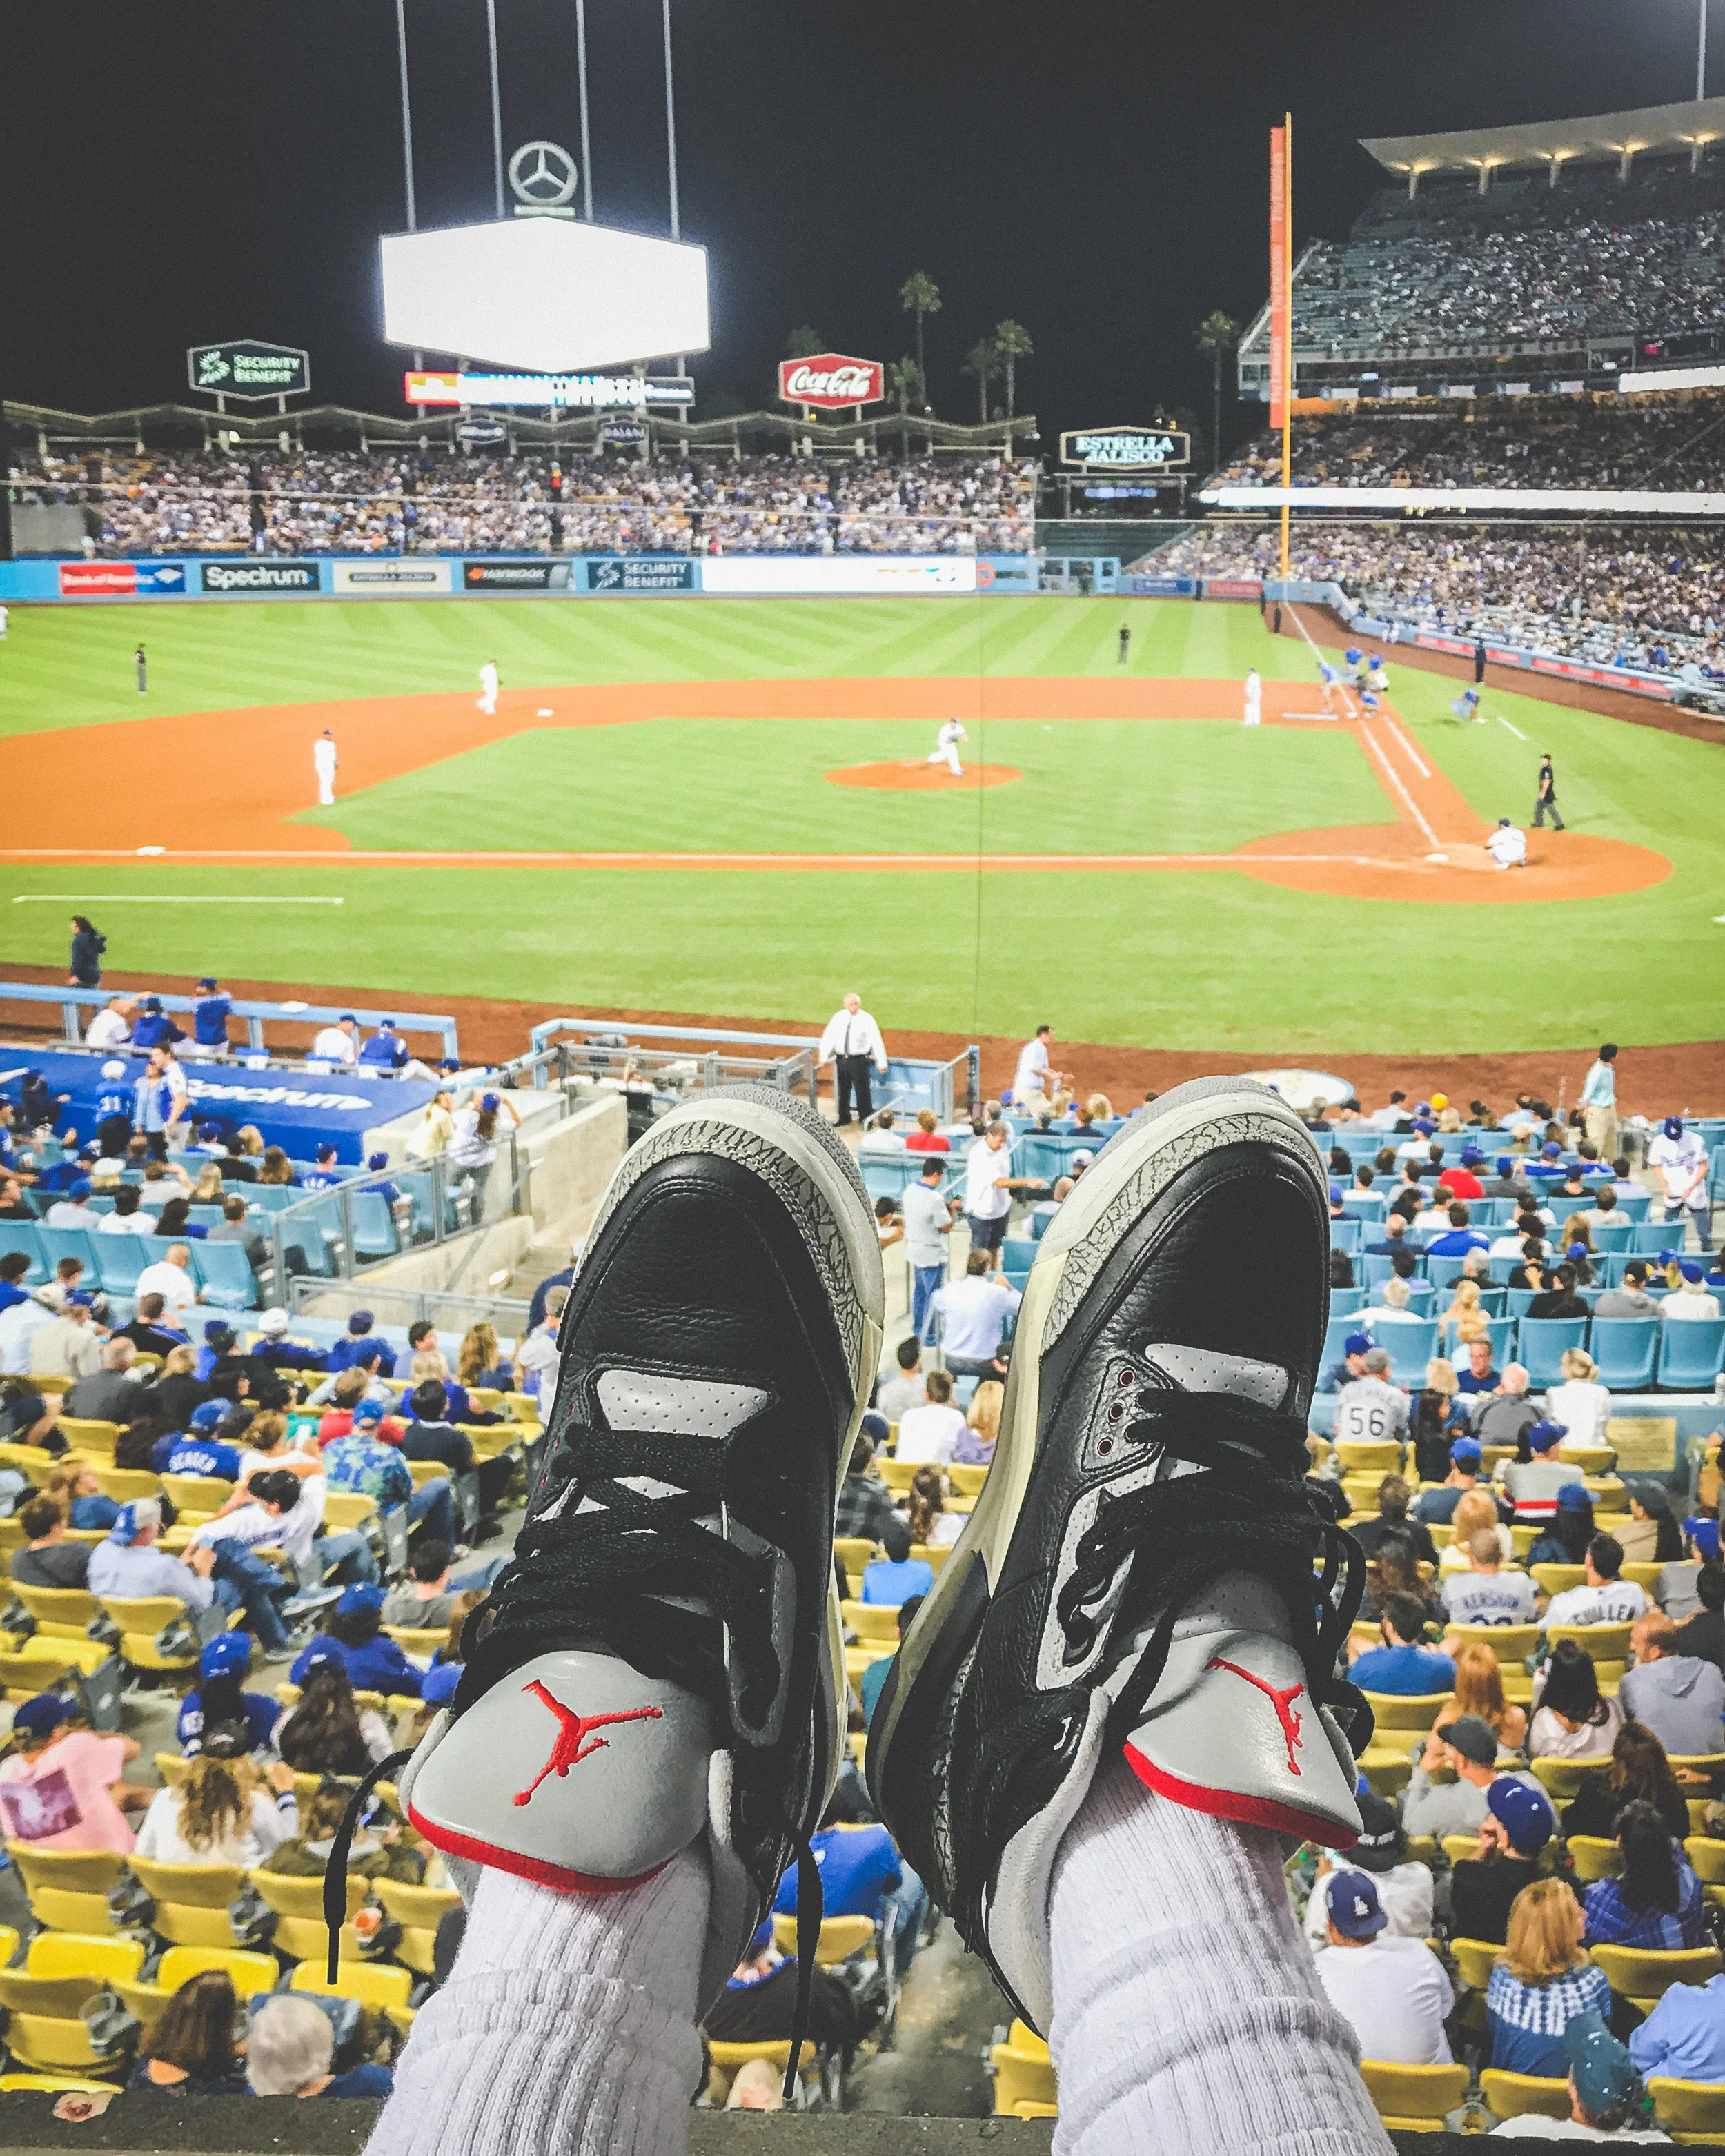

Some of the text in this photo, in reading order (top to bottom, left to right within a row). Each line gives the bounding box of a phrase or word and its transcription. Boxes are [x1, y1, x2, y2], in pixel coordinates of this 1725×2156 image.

[1076, 435, 1174, 452] ESTRELLA
[1084, 450, 1165, 464] JALISCO
[624, 562, 687, 574] SECURITY
[207, 566, 308, 589] Spectrum
[624, 576, 680, 587] BENEFIT
[1350, 1407, 1385, 1436] 56
